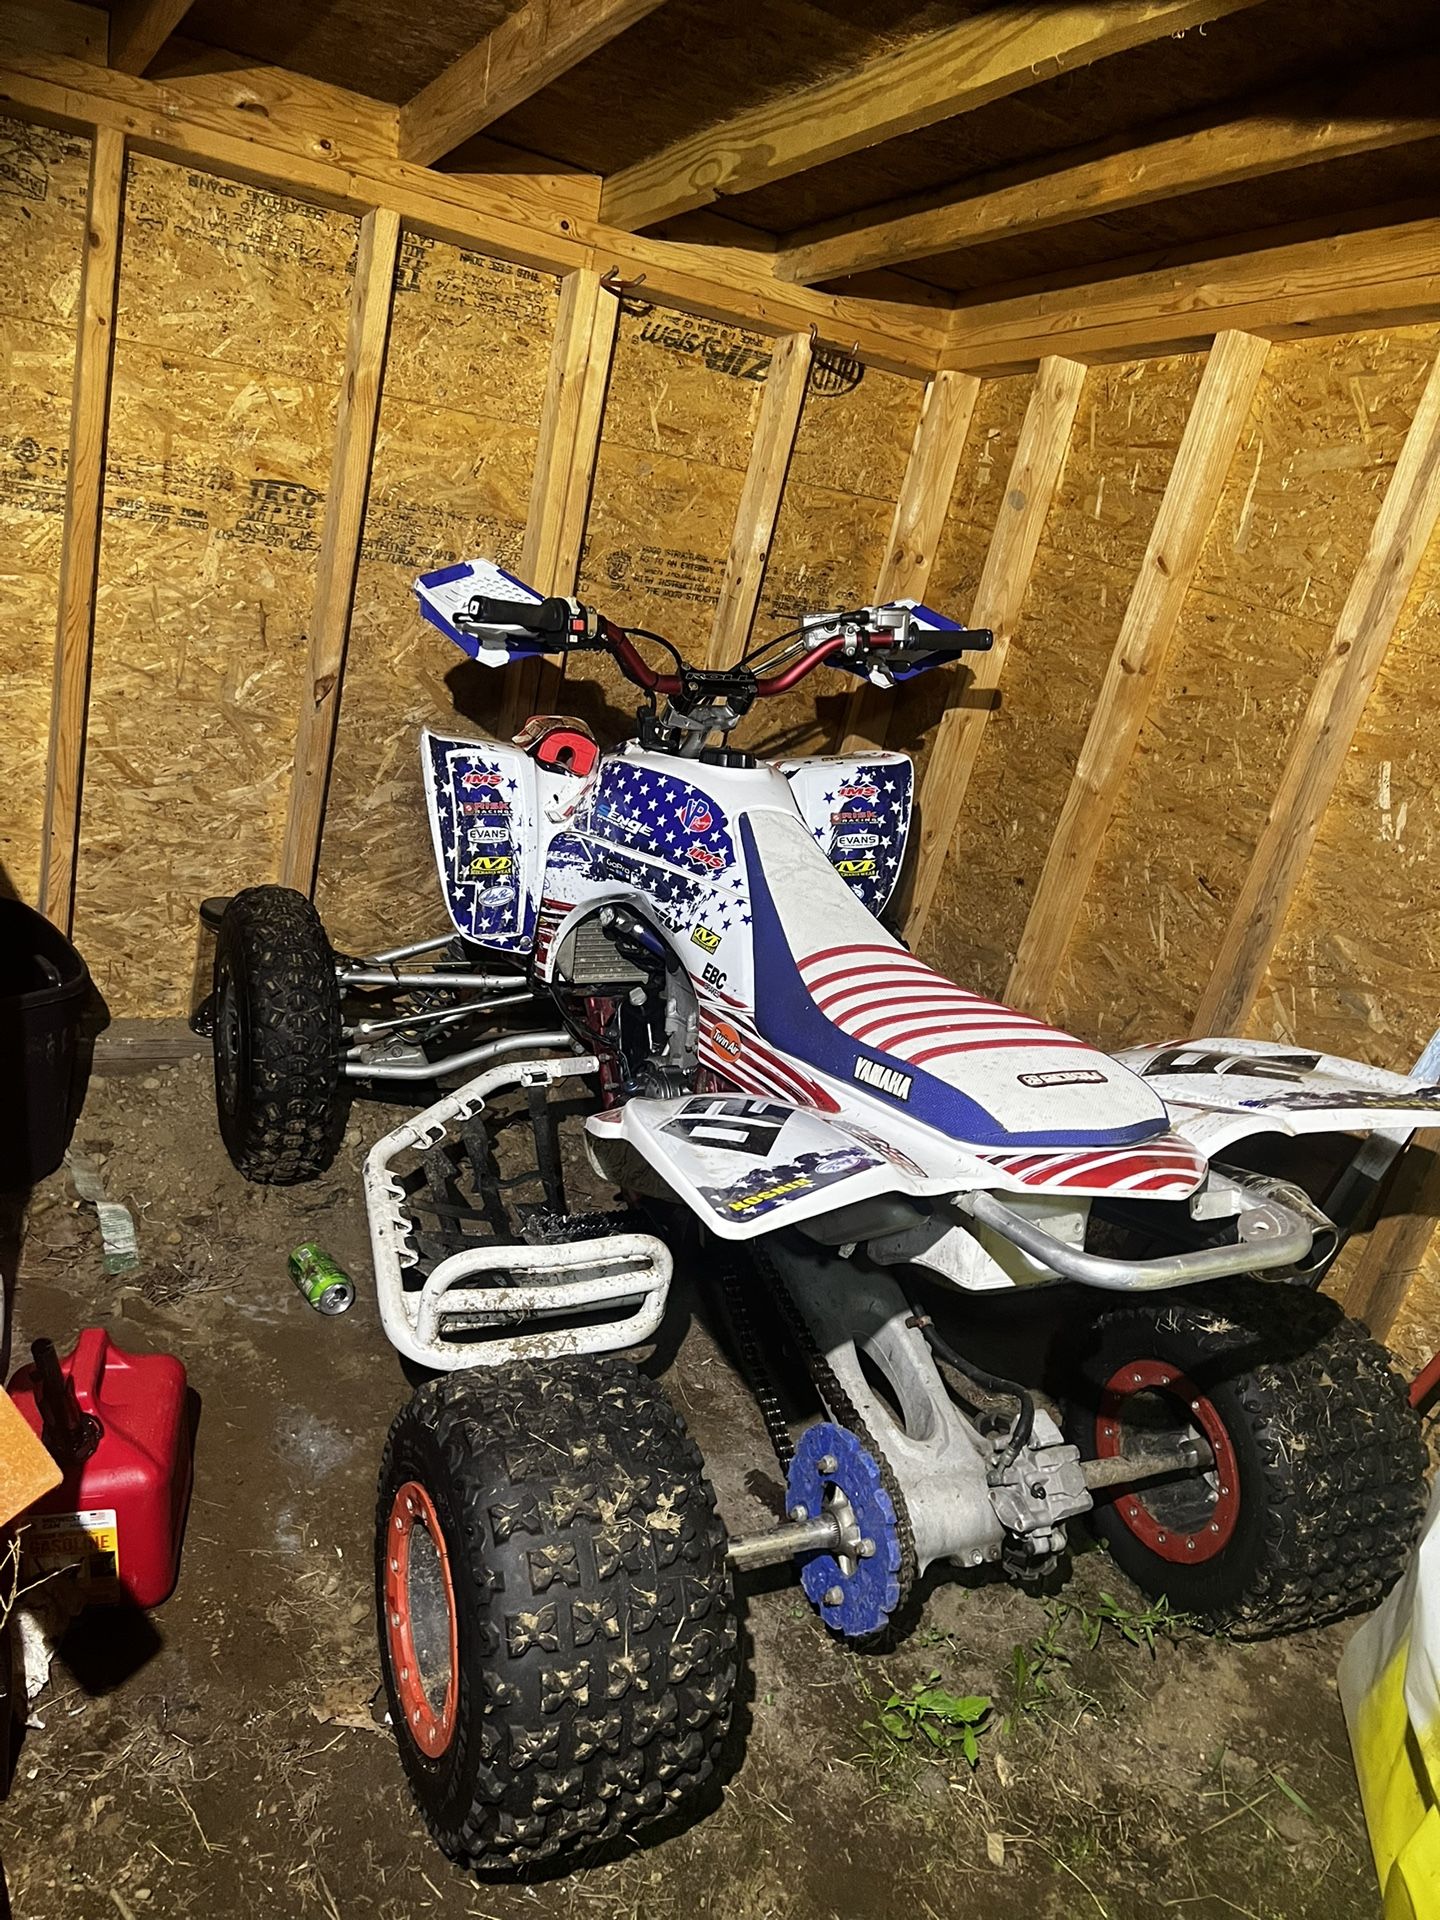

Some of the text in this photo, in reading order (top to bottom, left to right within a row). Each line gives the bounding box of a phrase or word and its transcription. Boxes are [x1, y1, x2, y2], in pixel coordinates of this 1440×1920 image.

[250, 483, 317, 506] TECO
[464, 774, 502, 784] IMS
[838, 787, 877, 796] IMS
[469, 829, 506, 838] EVANS
[839, 835, 876, 844] EVANS
[688, 846, 726, 869] IMS
[702, 962, 728, 990] EBC
[853, 1056, 912, 1100] YAMAHA
